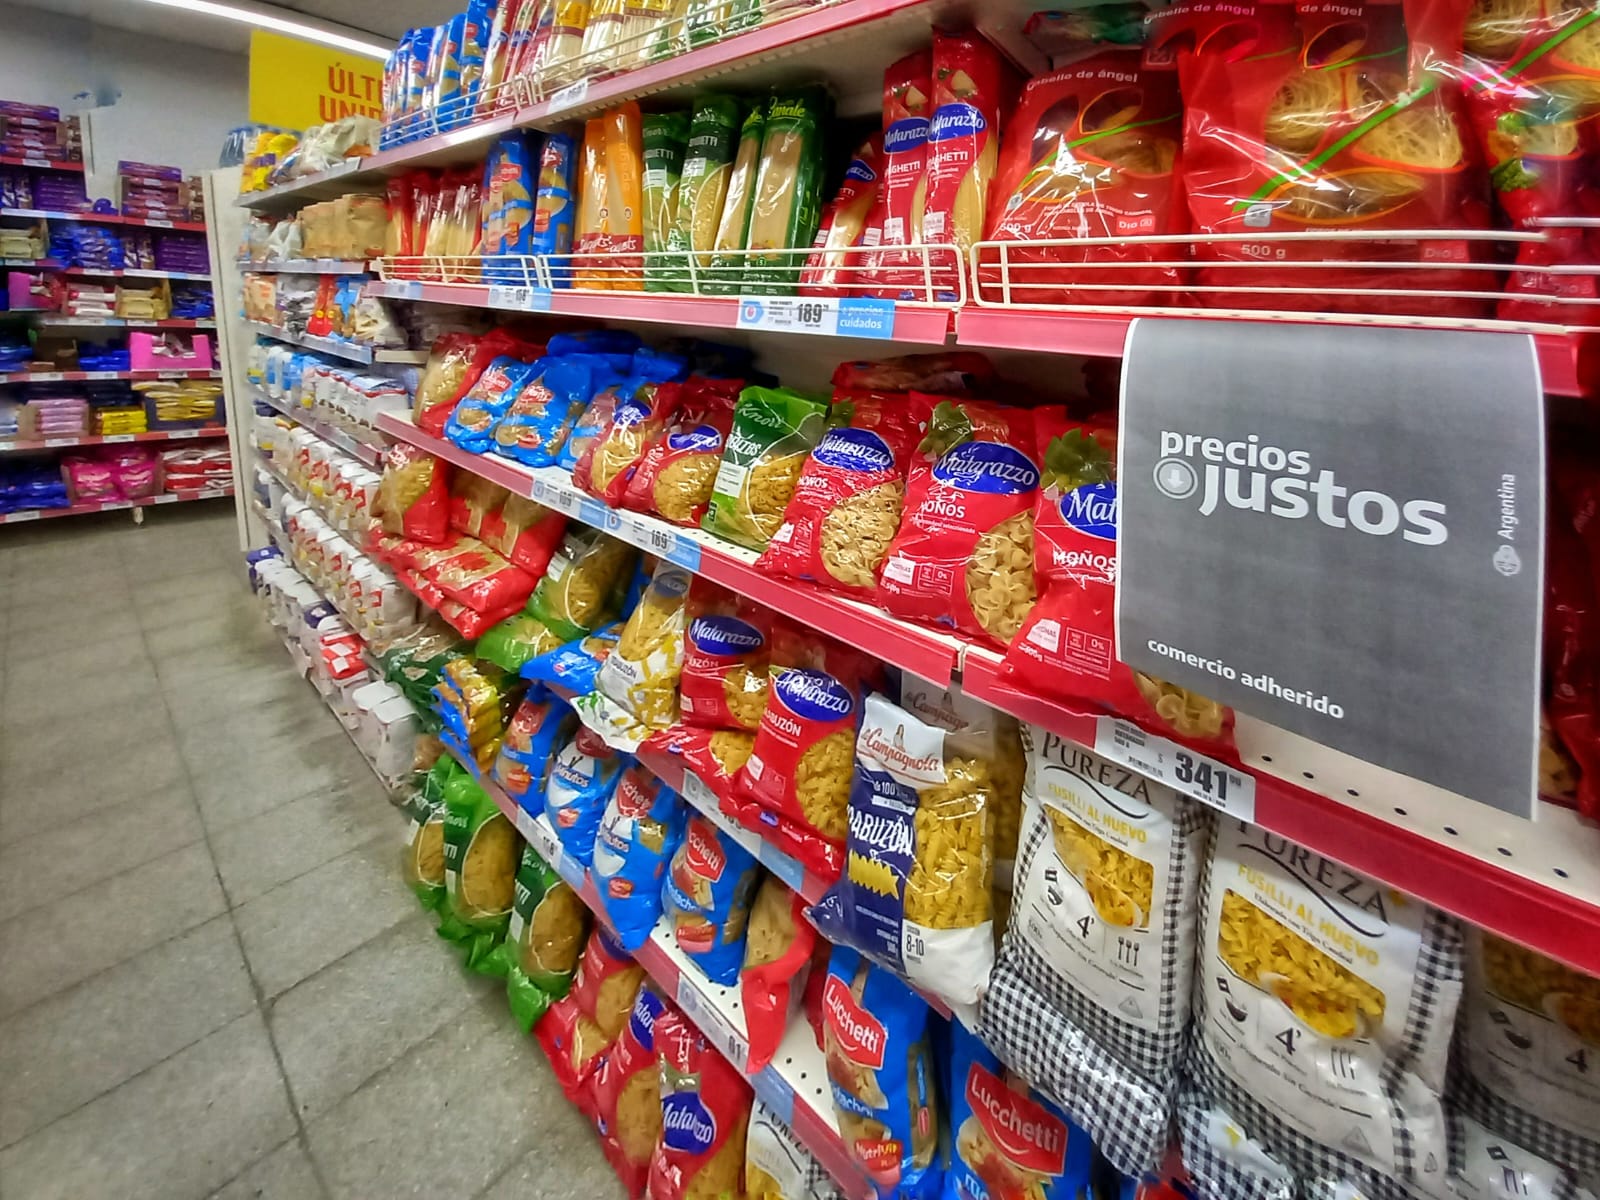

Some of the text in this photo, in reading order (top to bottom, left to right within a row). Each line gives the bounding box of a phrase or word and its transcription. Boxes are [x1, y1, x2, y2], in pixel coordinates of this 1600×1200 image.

[1193, 4, 1211, 12] de
[1215, 3, 1255, 16] ángel
[1322, 4, 1363, 16] ángel
[1076, 70, 1094, 79] de
[1097, 68, 1138, 83] ángel
[1241, 244, 1286, 259] 500 g
[798, 303, 823, 323] 189
[839, 318, 882, 329] cuidados
[935, 452, 1035, 486] Matarazzo
[1160, 430, 1311, 475] precios
[1198, 464, 1449, 546] justos
[1496, 473, 1517, 540] Argentina
[651, 530, 668, 549] 189
[691, 618, 761, 646] Matarazzo
[777, 671, 850, 714] Matarazzo
[1147, 639, 1236, 681] comercio
[1240, 671, 1345, 720] adherido
[866, 728, 939, 771] Campagnola
[1042, 731, 1152, 805] PUREZA
[881, 781, 896, 796] 100
[1175, 751, 1228, 801] 341
[1087, 804, 1100, 822] AL
[1102, 814, 1147, 843] HUEVO
[1238, 863, 1379, 966] FUSILLI AL HUEVO
[906, 934, 924, 956] 8-10
[826, 984, 880, 1054] Lucchetti
[971, 1073, 1059, 1153] Lucchetti
